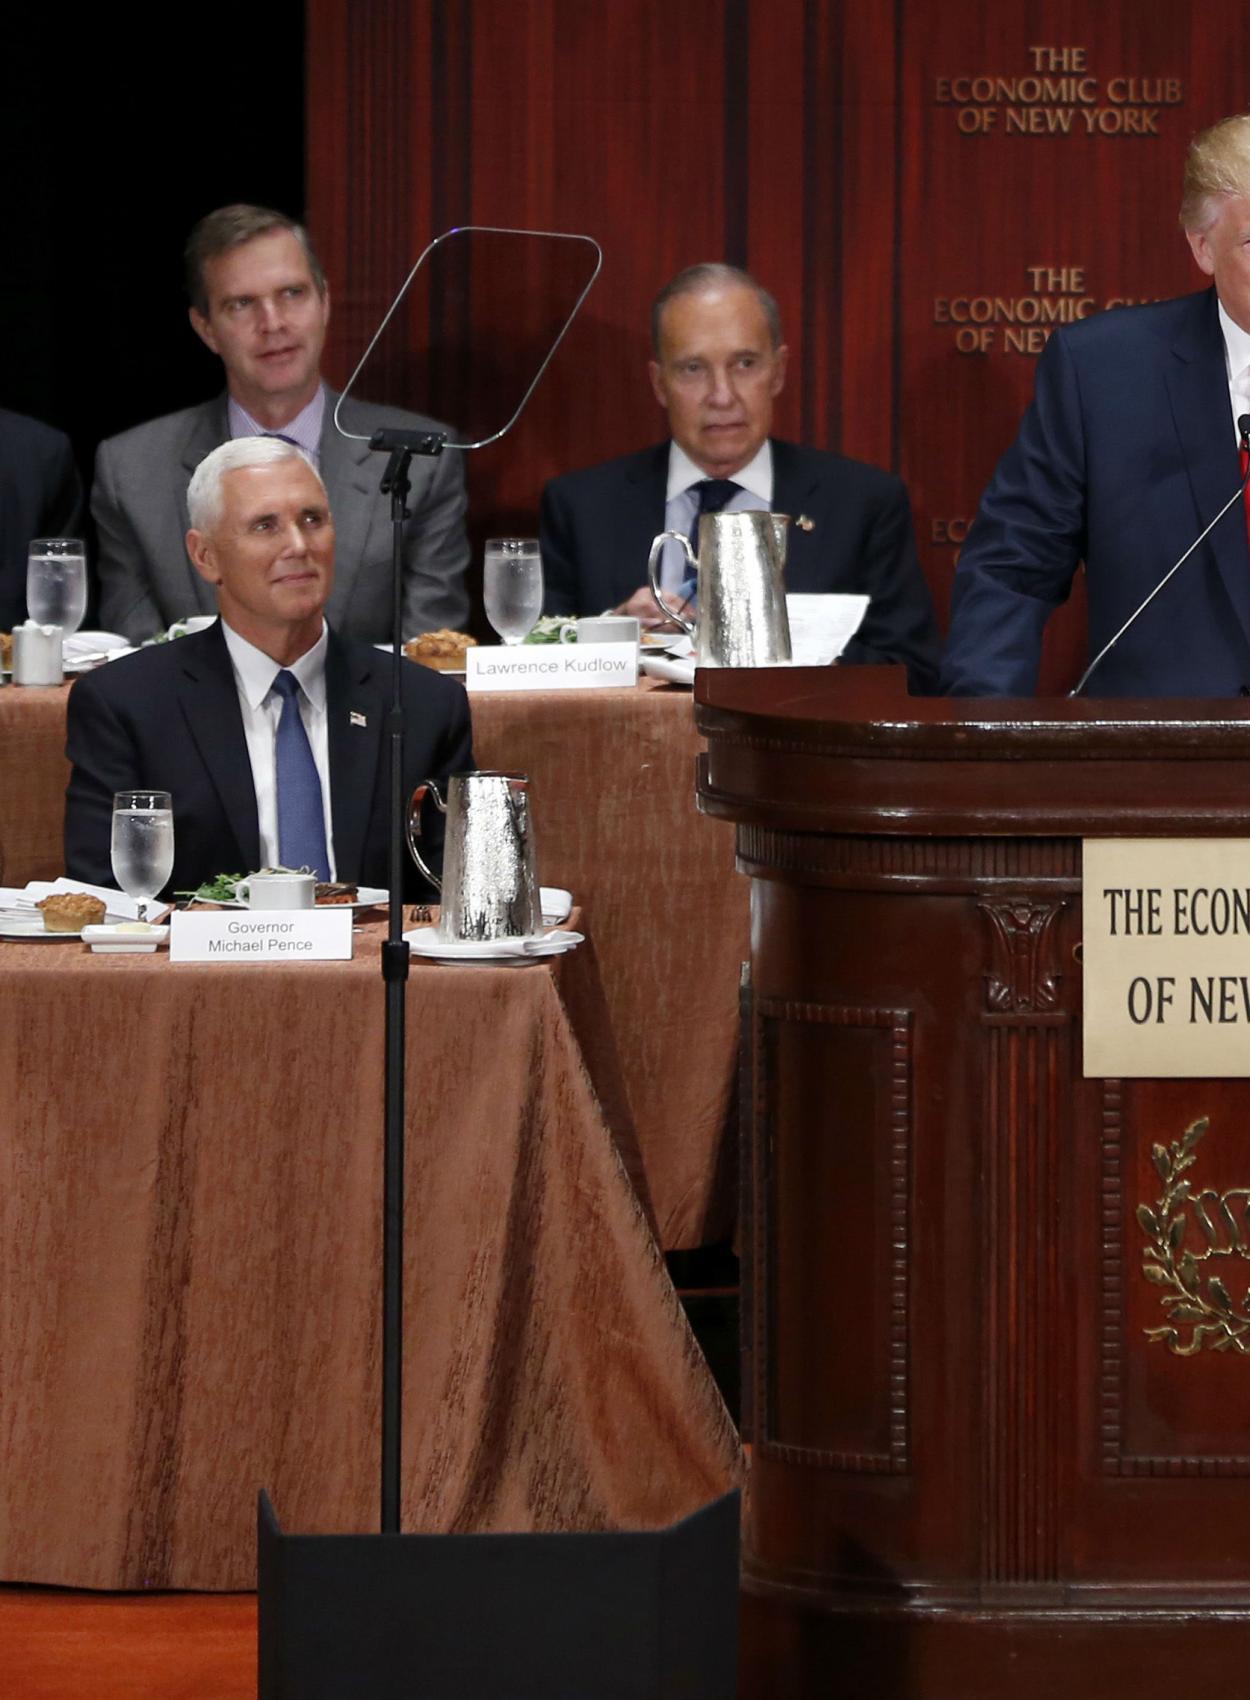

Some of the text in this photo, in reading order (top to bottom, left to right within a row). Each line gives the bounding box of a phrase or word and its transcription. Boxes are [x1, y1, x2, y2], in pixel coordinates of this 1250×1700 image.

[1029, 47, 1087, 72] THE
[936, 77, 1182, 104] ECONOMIC CLUB
[957, 107, 1159, 133] OF NEW YORK
[1027, 267, 1085, 292] THE
[934, 298, 1095, 323] ECONOMIC
[956, 327, 995, 353] OF
[476, 657, 628, 676] Lawrence Kudlow
[1103, 888, 1163, 936] THE
[228, 921, 295, 934] Governor
[208, 938, 314, 953] Michael Pence
[1127, 976, 1176, 1025] OF
